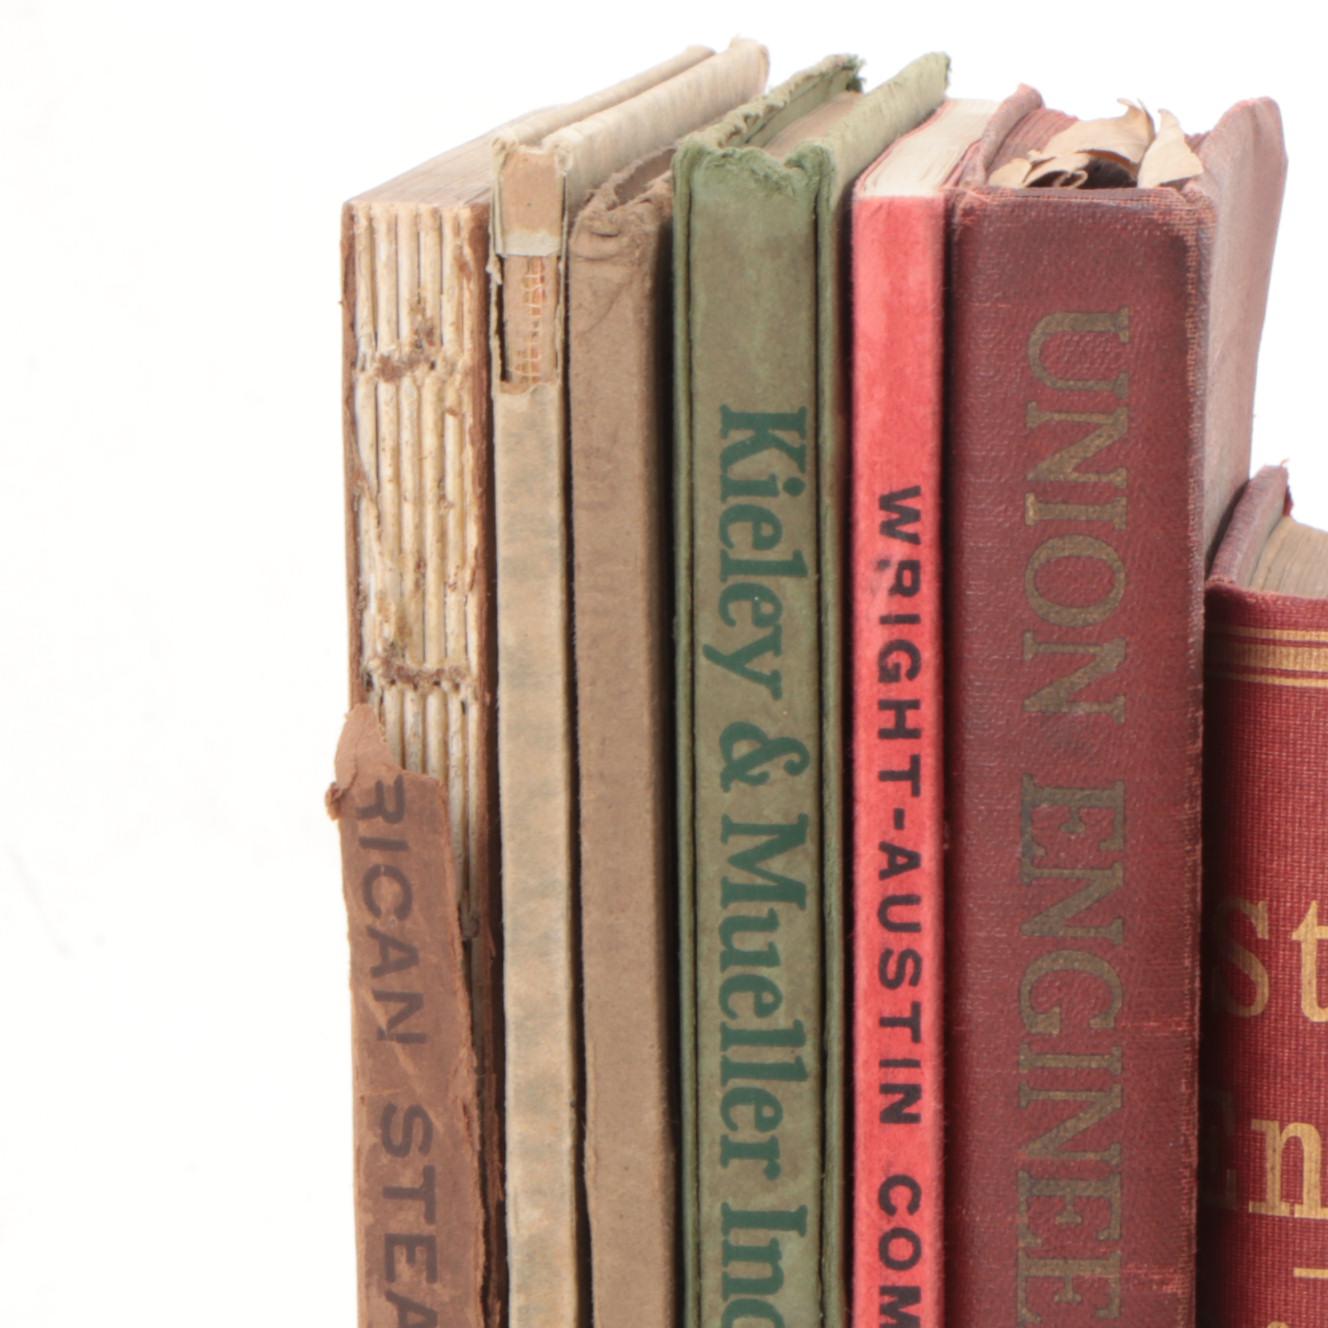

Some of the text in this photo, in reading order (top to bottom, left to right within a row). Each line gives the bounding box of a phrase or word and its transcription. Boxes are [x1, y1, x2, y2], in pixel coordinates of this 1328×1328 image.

[704, 404, 809, 699] Kieley
[1022, 308, 1130, 725] UNION
[718, 721, 810, 794] &
[876, 485, 922, 1126] WRIGHT-AUSTIN
[716, 813, 810, 1180] Mueller
